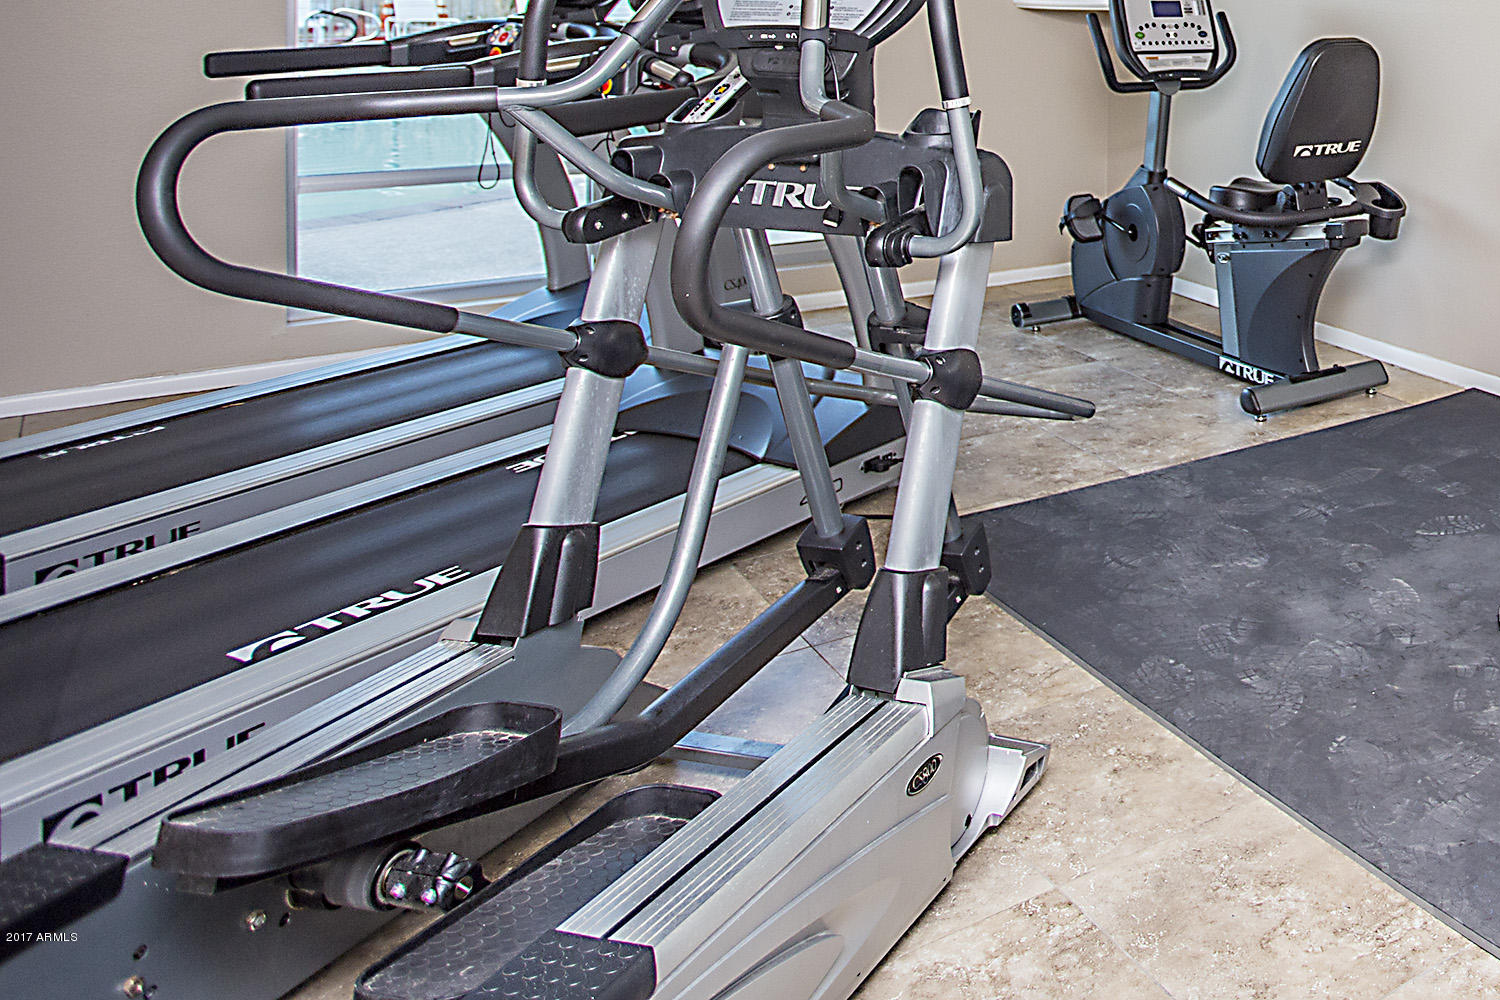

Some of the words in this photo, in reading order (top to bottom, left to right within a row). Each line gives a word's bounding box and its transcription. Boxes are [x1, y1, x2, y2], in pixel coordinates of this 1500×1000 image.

[1314, 140, 1362, 156] TRUE
[745, 179, 863, 210] TRU
[1234, 361, 1274, 385] TRUE
[293, 564, 471, 630] TRUE
